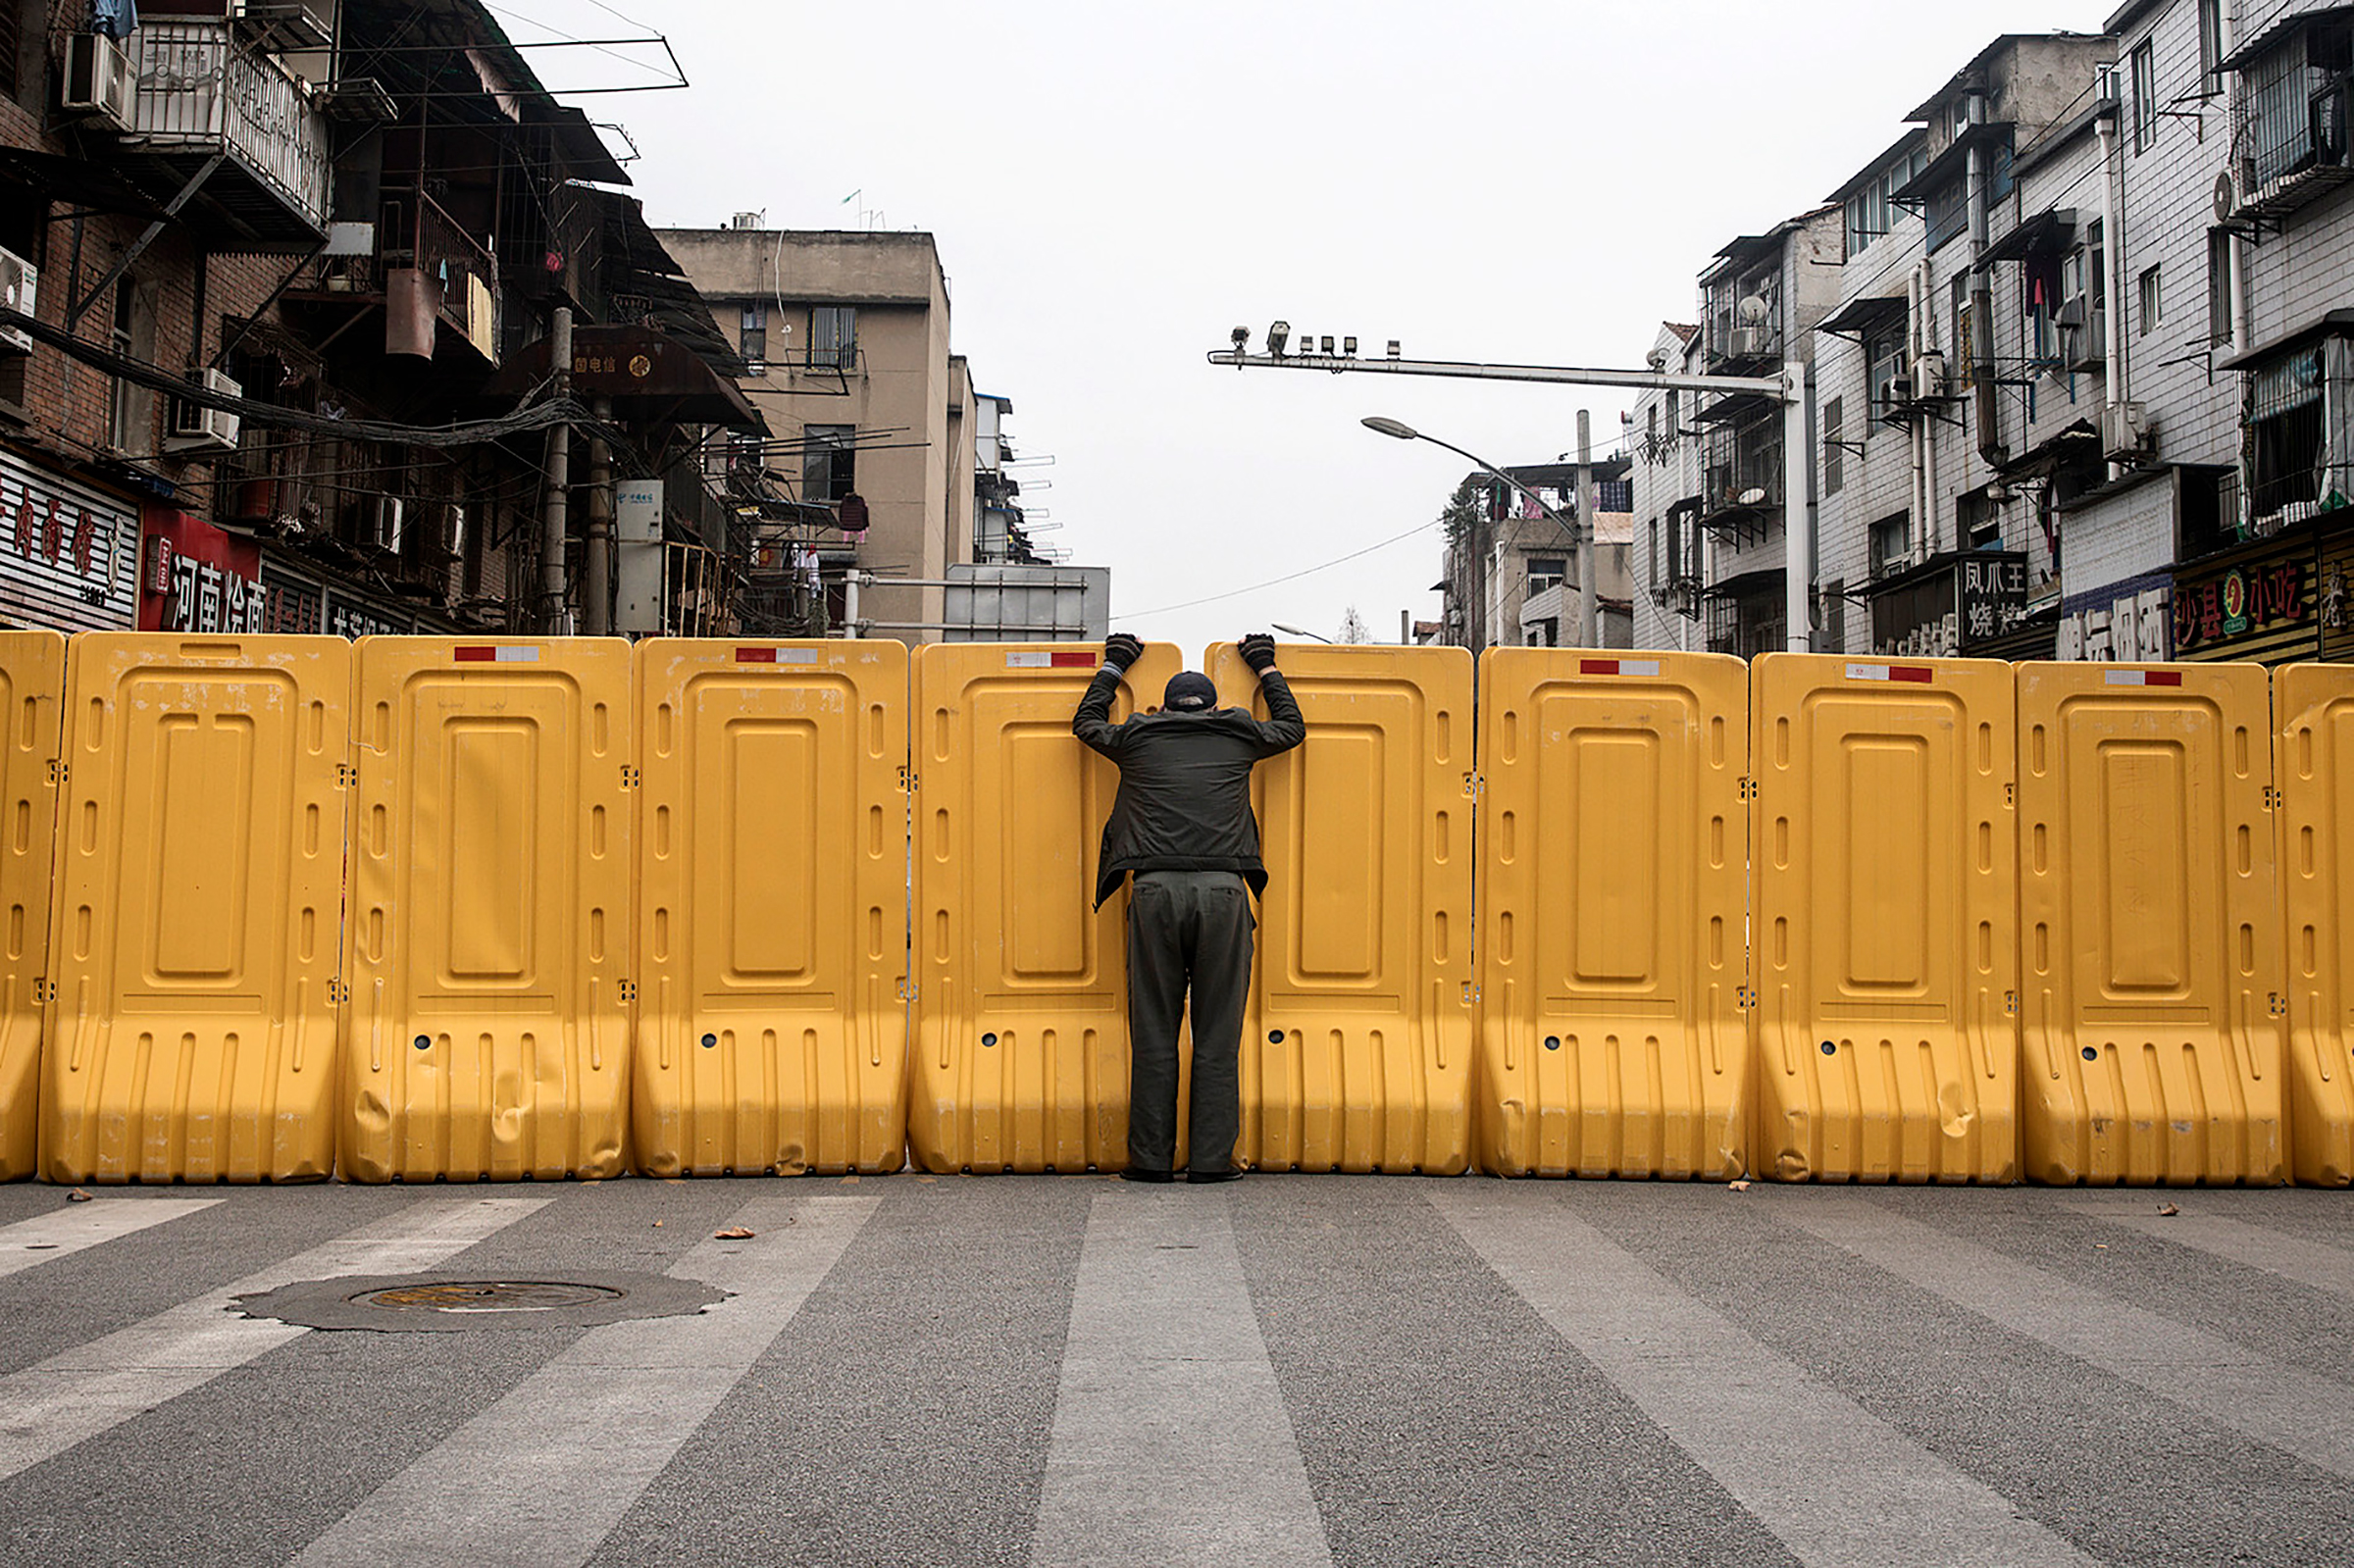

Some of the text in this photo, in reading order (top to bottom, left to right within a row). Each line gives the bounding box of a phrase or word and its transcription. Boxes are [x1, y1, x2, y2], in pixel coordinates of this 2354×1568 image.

[0, 478, 96, 577] 肉面馆
[1965, 561, 2025, 594] 凤爪王
